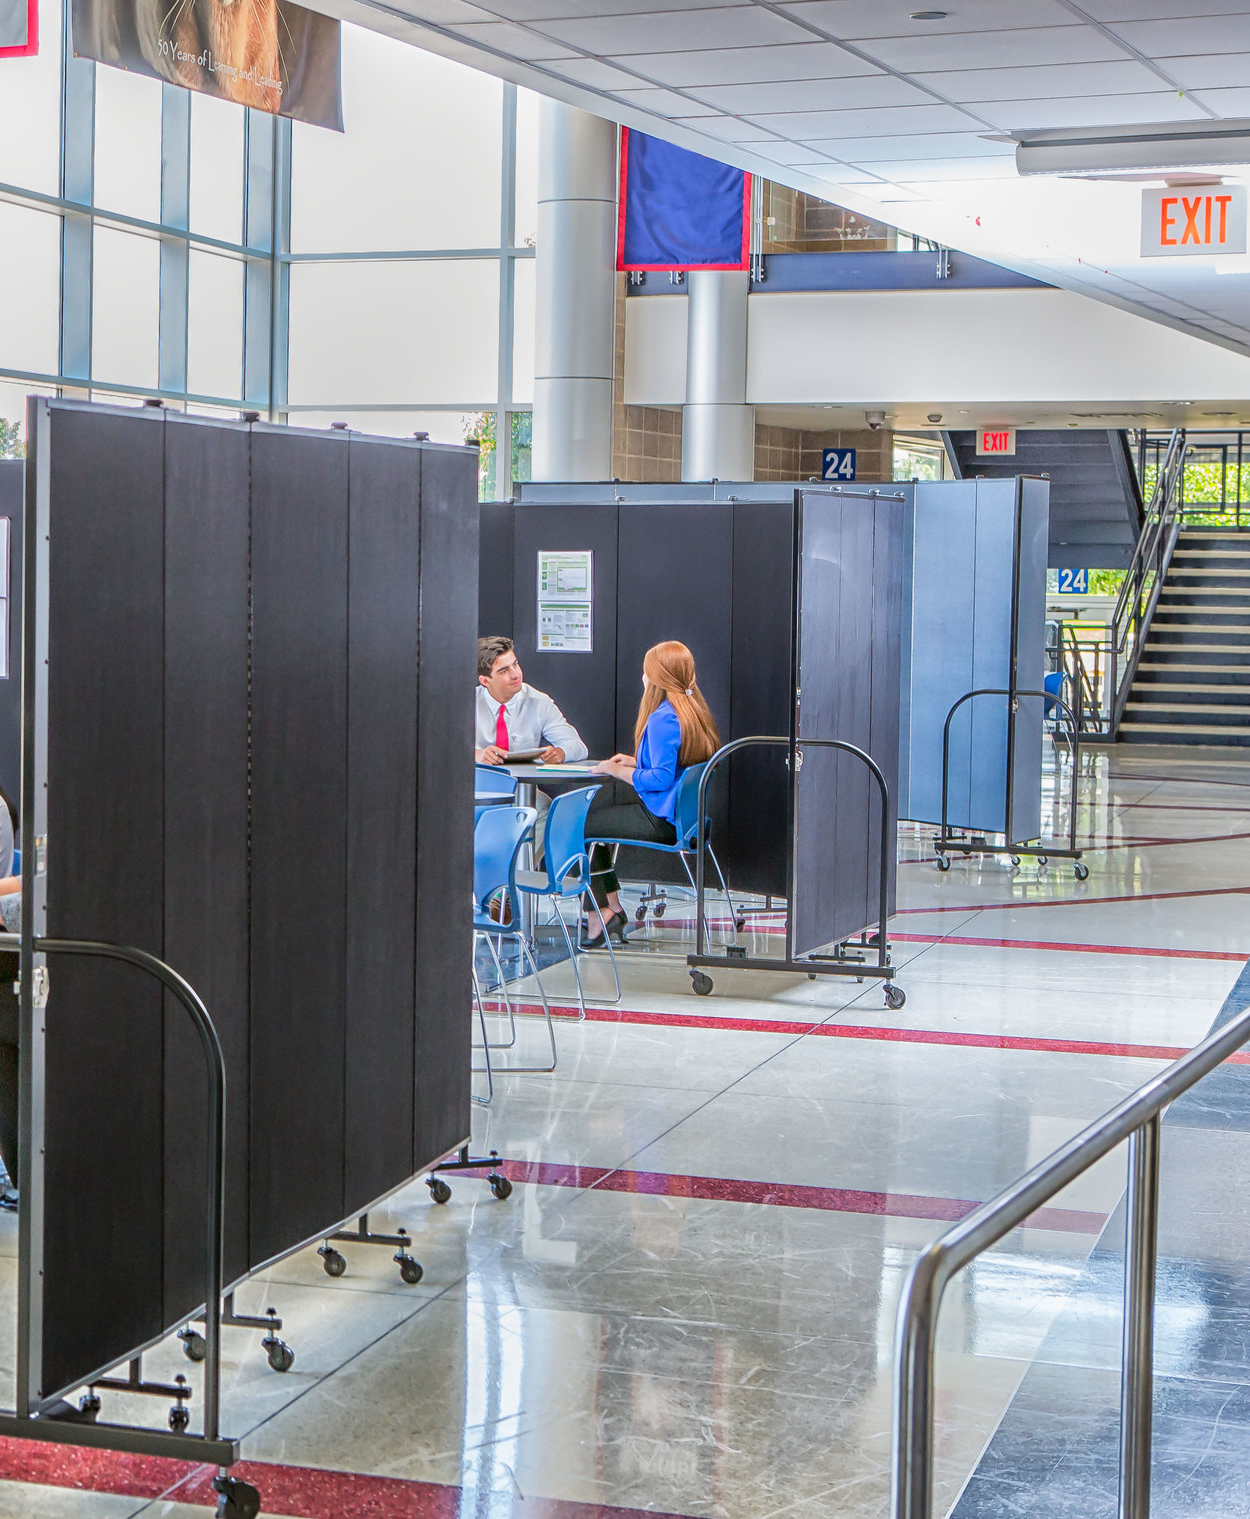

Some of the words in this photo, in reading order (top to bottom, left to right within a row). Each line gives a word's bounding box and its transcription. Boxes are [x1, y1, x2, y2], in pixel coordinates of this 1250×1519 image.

[157, 39, 169, 57] 50
[169, 40, 196, 65] Years
[197, 49, 208, 67] of
[208, 51, 238, 82] Learning
[239, 66, 254, 81] and
[254, 66, 283, 96] Leading
[1160, 195, 1232, 245] EXIT
[983, 432, 1010, 451] EXIT
[825, 452, 854, 479] 24
[1060, 568, 1087, 592] 24
